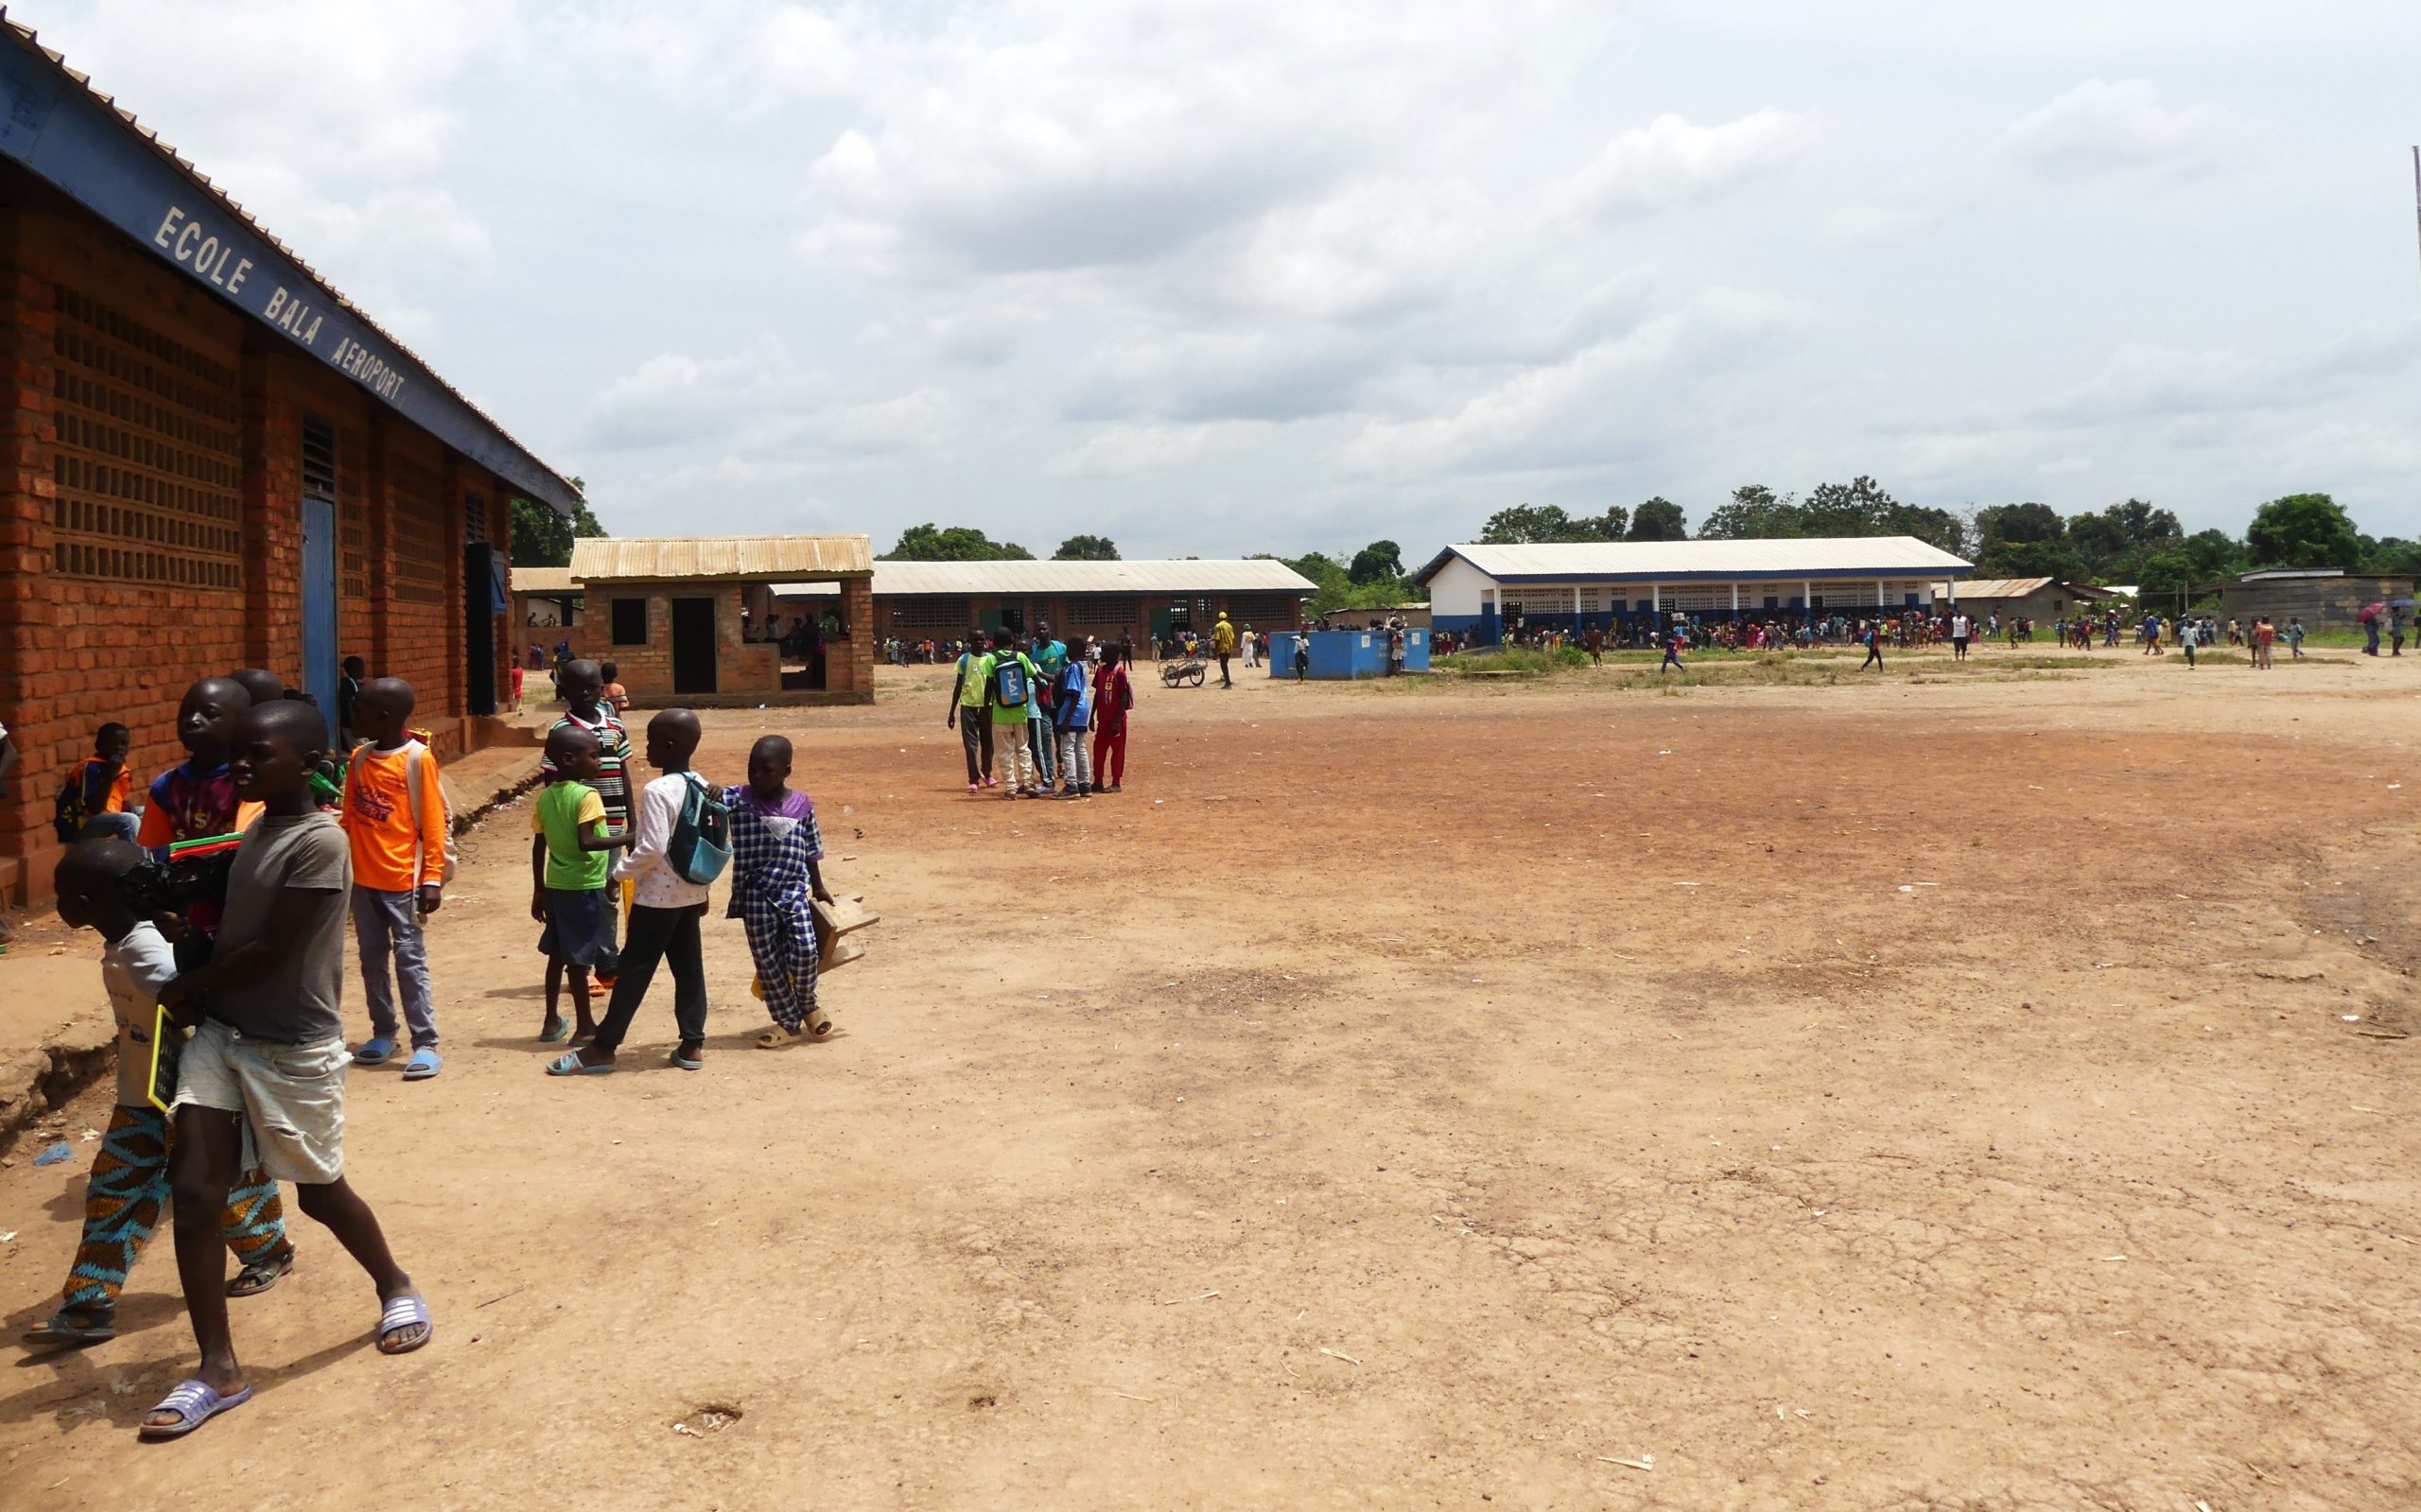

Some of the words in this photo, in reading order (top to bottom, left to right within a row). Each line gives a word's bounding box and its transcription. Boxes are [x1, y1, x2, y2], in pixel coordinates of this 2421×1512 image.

[154, 206, 253, 294] ECOLE
[264, 287, 323, 345] BALA
[331, 337, 405, 400] AEROPORT
